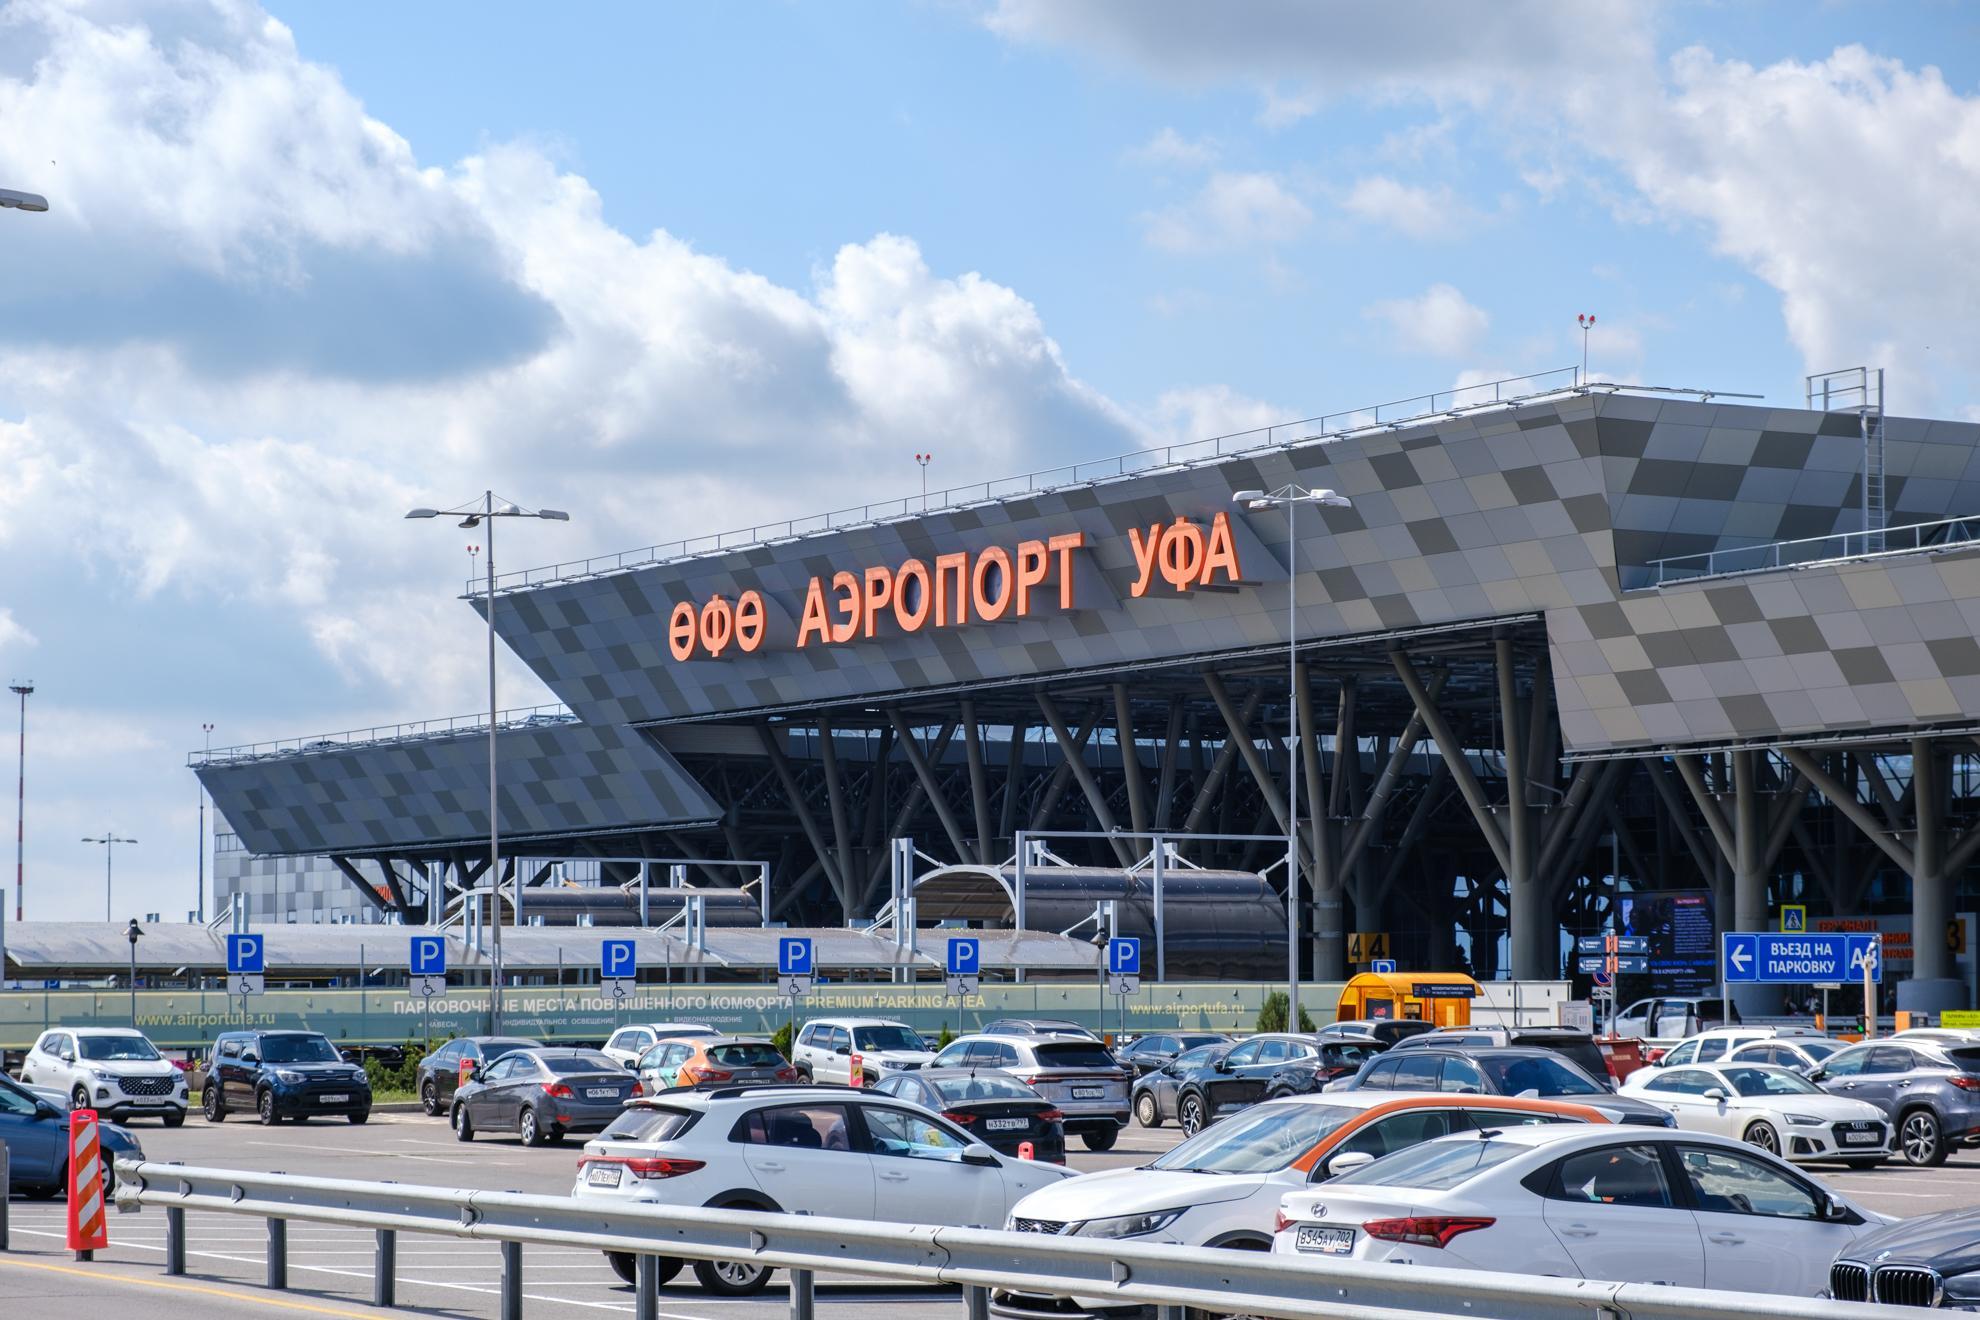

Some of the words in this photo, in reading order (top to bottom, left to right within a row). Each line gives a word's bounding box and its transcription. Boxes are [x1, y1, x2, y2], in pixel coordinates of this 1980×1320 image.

[797, 532, 1083, 648] АЭРОПОРТ
[1128, 512, 1242, 598] УФА
[1351, 934, 1362, 961] 4
[1369, 934, 1385, 961] 4
[1947, 919, 1960, 950] 3
[237, 938, 257, 968] P
[420, 940, 439, 970] P
[611, 943, 630, 973] P
[787, 941, 806, 970] P
[956, 942, 974, 970] P
[1117, 942, 1134, 970] P
[1771, 943, 1812, 958] ВЪЕЗД
[1815, 943, 1832, 955] НА
[1768, 960, 1836, 974] ПАРКОВКУ
[523, 999, 575, 1013] МЕСТА
[581, 997, 707, 1012] ПОВЫШЕННОГО
[711, 995, 794, 1010] КОМФОРТА
[805, 995, 874, 1009] PREMIUM
[878, 994, 942, 1009] PARKING
[1129, 1001, 1245, 1017] www.airportufa.ru
[134, 1011, 276, 1028] www.airportufa.ru
[502, 1018, 567, 1027] ИНДИВИДУАЛЬНОЕ
[571, 1016, 616, 1025] ОСВЕЩЕНИЕ
[673, 1015, 743, 1024] ВИДЕОНАБЛЮДЕНИЕ
[1336, 1231, 1350, 1243] 702
